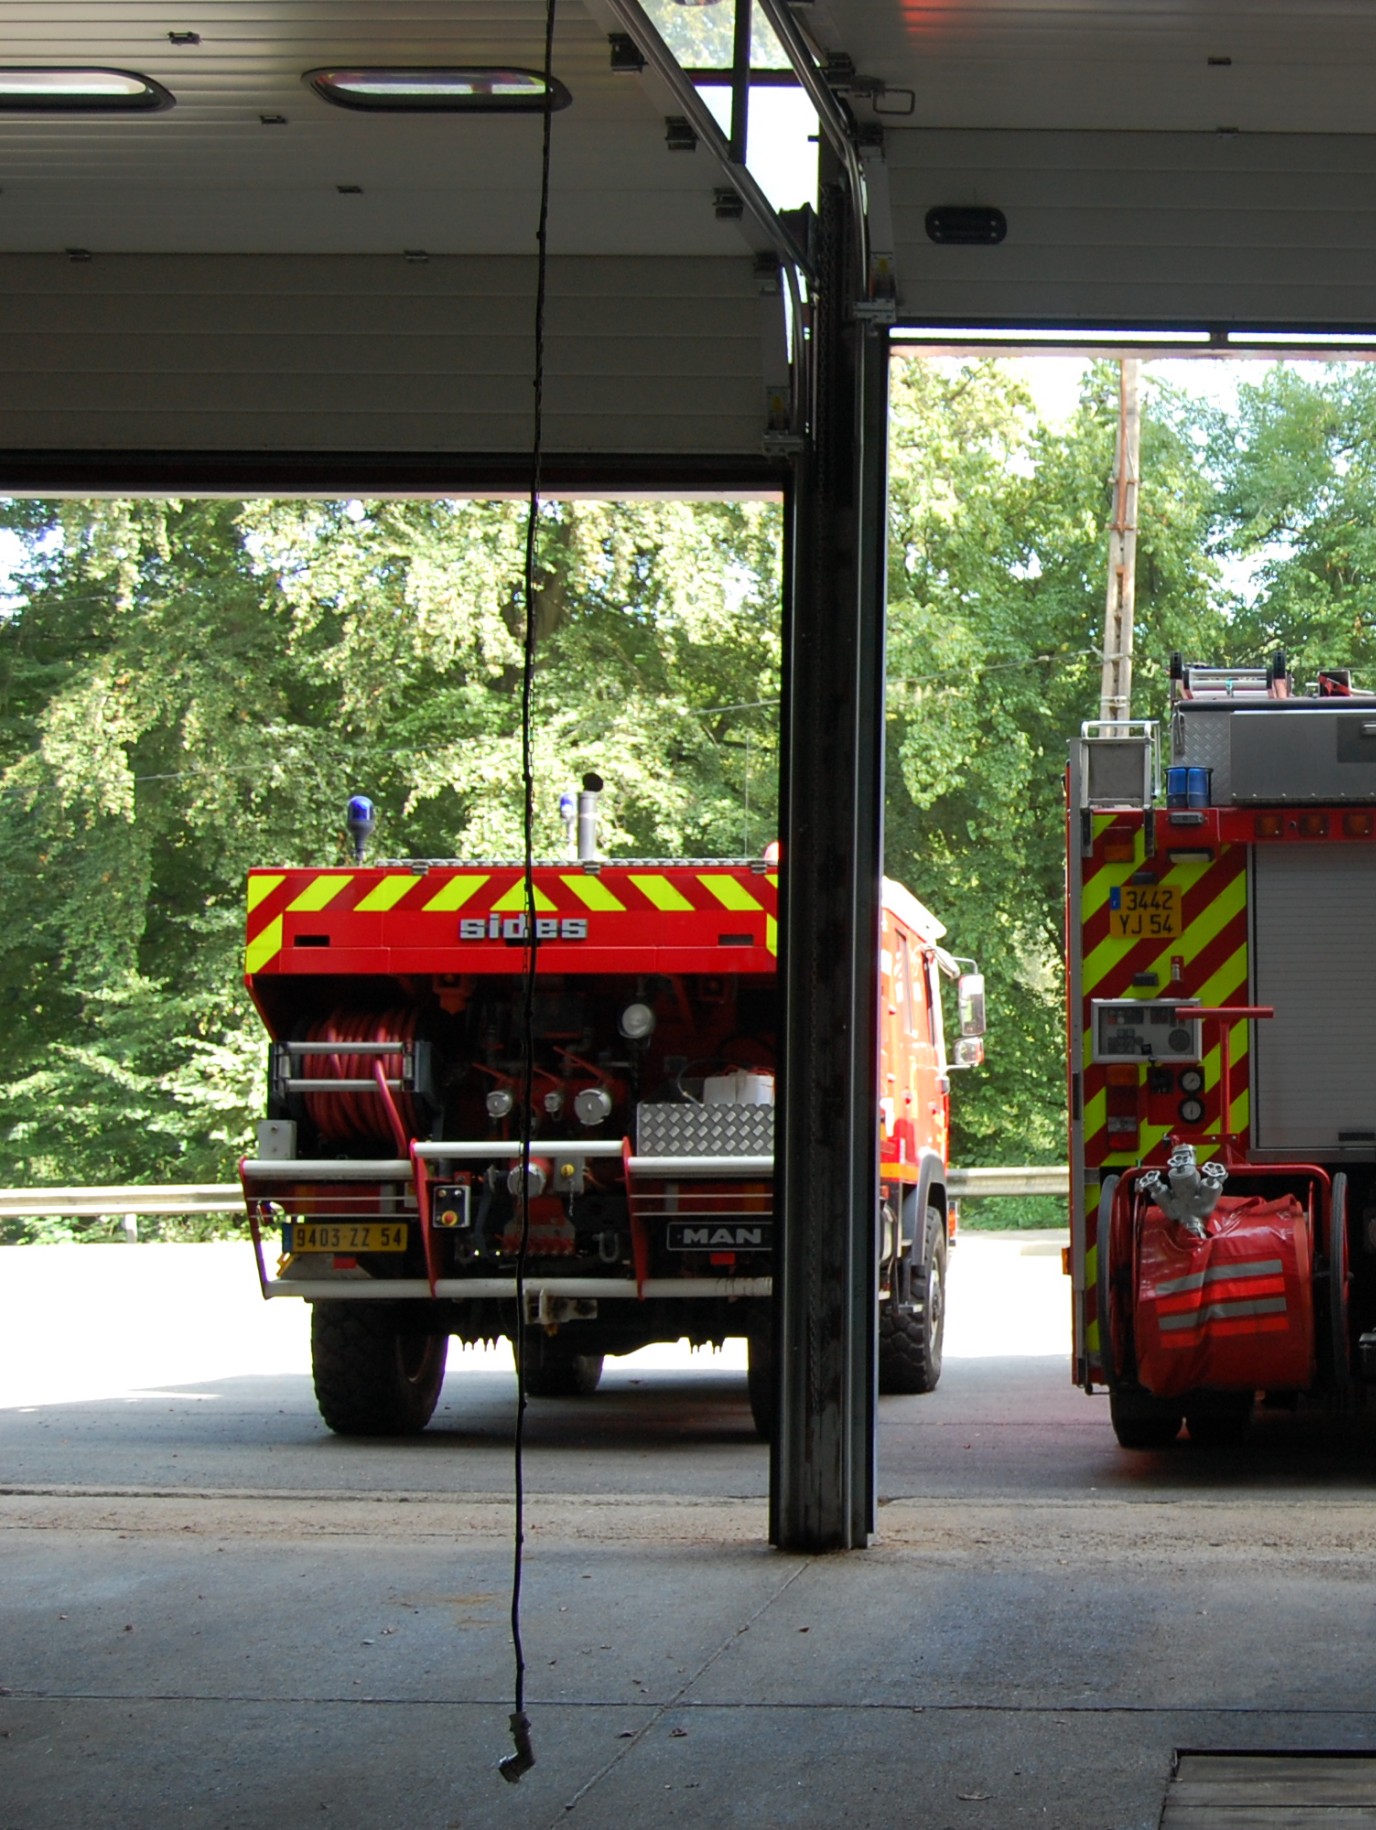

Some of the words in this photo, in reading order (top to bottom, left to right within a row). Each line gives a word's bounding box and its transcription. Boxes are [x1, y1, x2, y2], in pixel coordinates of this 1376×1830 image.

[1126, 890, 1173, 911] 3442
[460, 913, 587, 939] sides
[1119, 914, 1143, 935] YJ
[1149, 914, 1173, 934] 54
[297, 1228, 340, 1247] 9403
[350, 1228, 370, 1247] ZZ
[381, 1228, 402, 1246] 54
[683, 1228, 762, 1244] MAN
